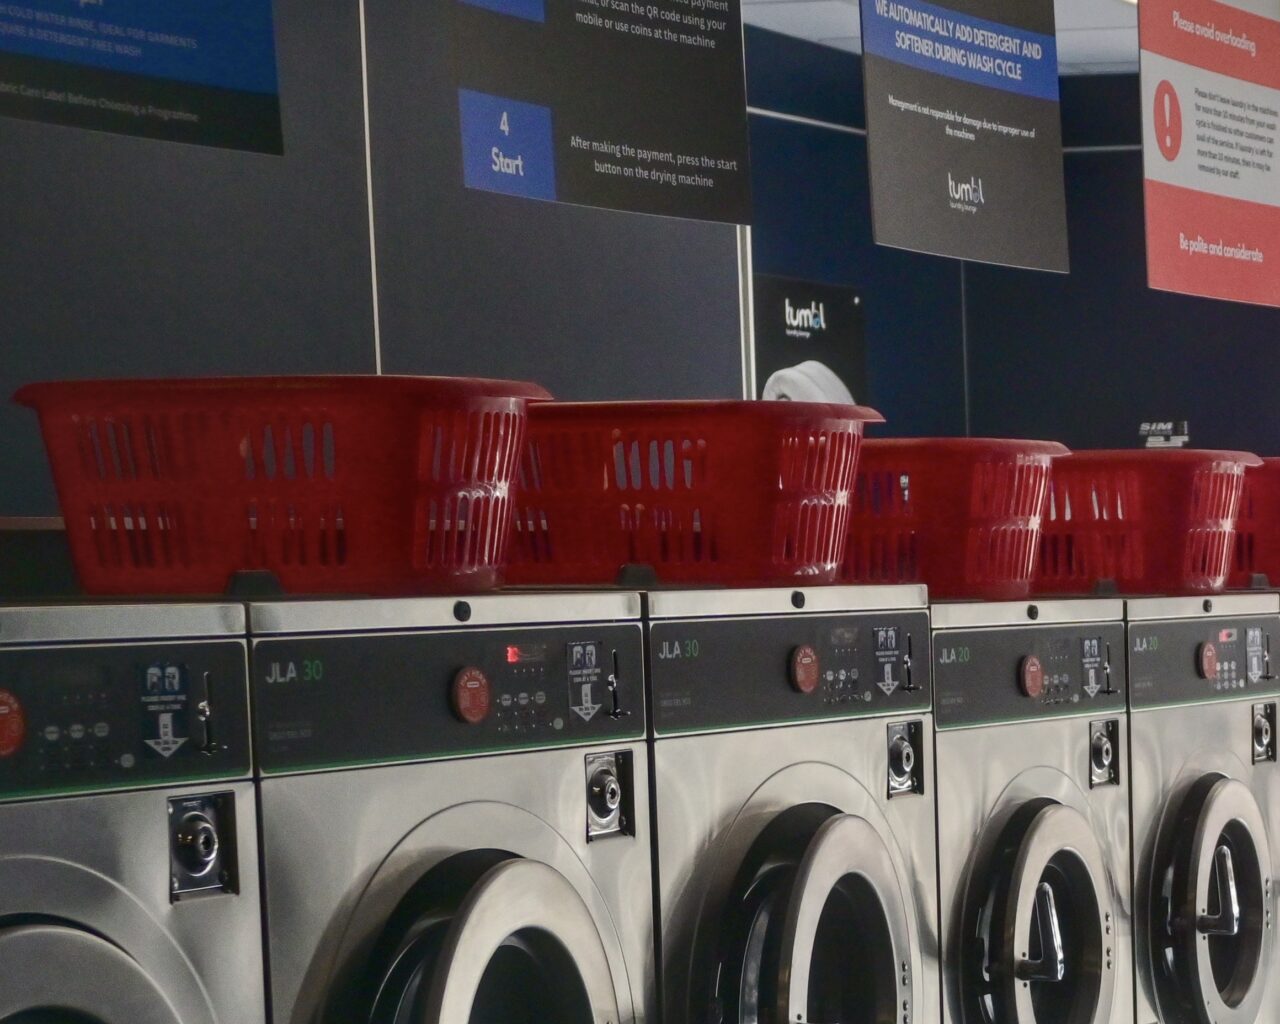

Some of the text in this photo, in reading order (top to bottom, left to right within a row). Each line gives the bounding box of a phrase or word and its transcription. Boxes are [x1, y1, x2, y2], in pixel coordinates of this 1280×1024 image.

[576, 11, 716, 49] mobile or use coins at the machine
[611, 0, 629, 13] scan
[631, 2, 645, 15] the
[646, 5, 659, 20] QR
[660, 10, 681, 22] code
[682, 15, 705, 30] using
[707, 20, 726, 31] your
[875, 0, 1042, 60] WE AUTOMATICALLY ADD DETERGENT AND
[147, 31, 198, 49] GARMENTS
[1172, 10, 1257, 57] Please avoid overloading
[895, 30, 1022, 80] SOFTENER DURING WASH CYCLE
[500, 112, 509, 136] 4
[491, 147, 524, 176] Start
[570, 136, 738, 171] After making the payment, press the start
[594, 160, 714, 188] button on the drying machine
[1180, 232, 1264, 263] Be polite and considerate
[659, 639, 699, 659] JLA 30
[940, 647, 970, 664] JLA 20
[1134, 637, 1147, 652] JLA
[265, 659, 323, 684] JLA 30
